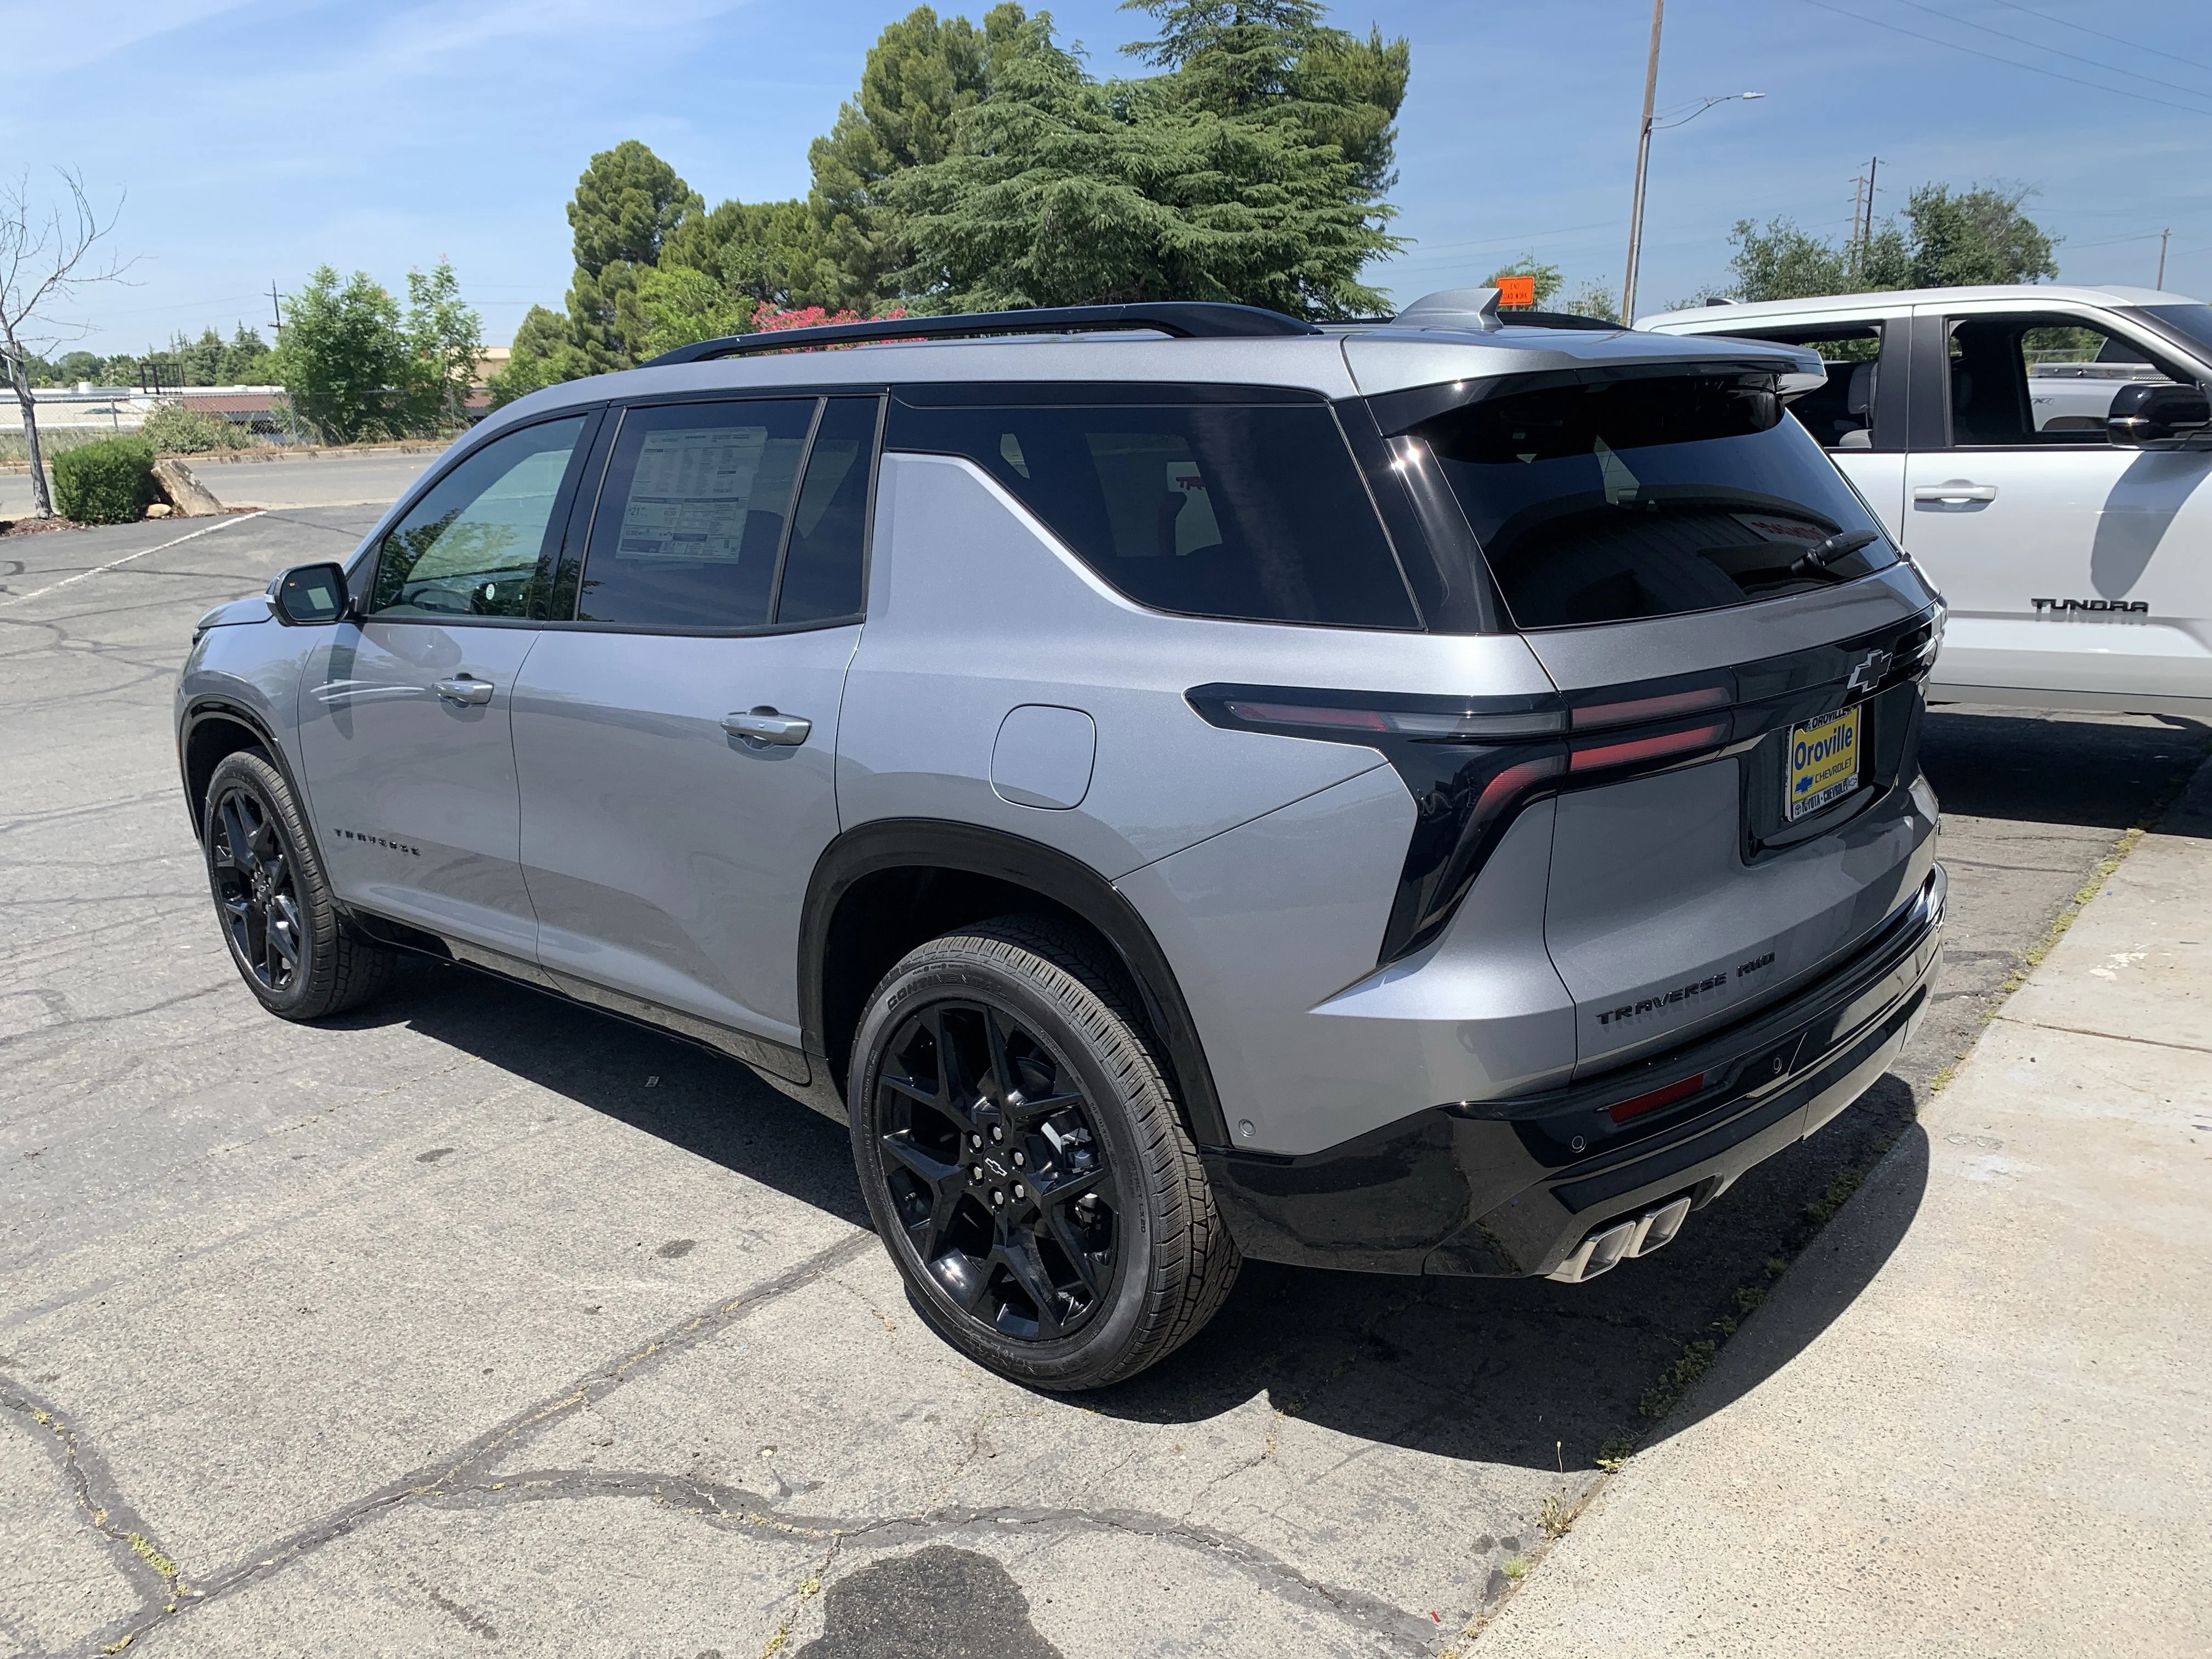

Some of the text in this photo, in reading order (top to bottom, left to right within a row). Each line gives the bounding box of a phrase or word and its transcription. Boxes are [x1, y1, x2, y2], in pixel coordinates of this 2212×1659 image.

[2031, 598, 2149, 612] TUNDRA
[1795, 724, 1853, 770] Oroville
[1815, 757, 1852, 783] CHEVROLET
[1802, 780, 1848, 813] TOYOTA CHEVROLET
[333, 828, 421, 856] TRAVERSE
[887, 973, 1007, 1011] CONTINENTAL
[1596, 972, 1726, 1025] TRAVERSE
